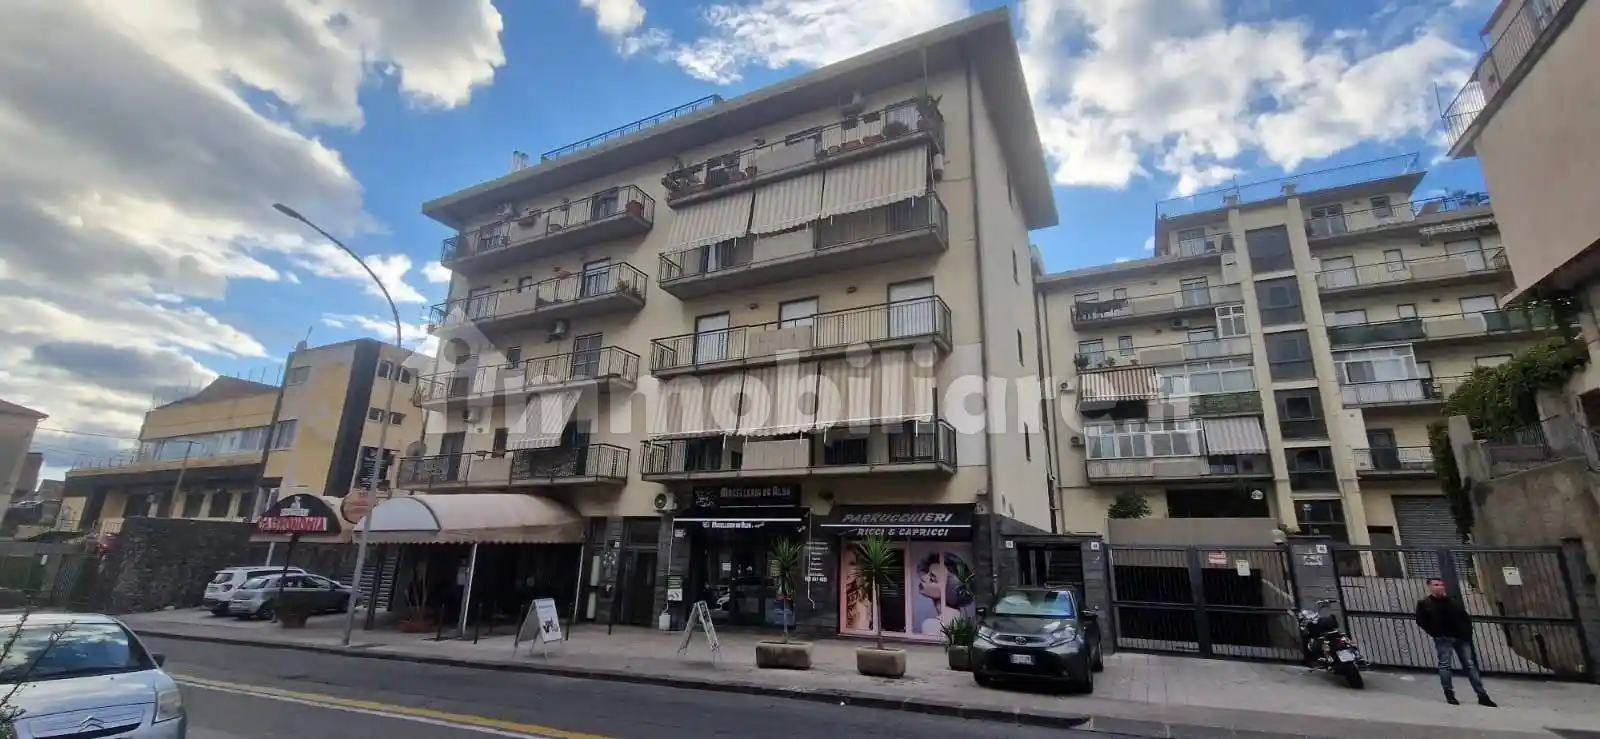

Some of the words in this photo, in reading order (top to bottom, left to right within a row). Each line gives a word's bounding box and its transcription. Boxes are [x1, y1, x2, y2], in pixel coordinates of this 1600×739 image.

[842, 512, 953, 523] PARRUCCHIERI
[856, 528, 885, 536] RICCI
[888, 528, 896, 536] &
[899, 528, 949, 536] CAPRICCI
